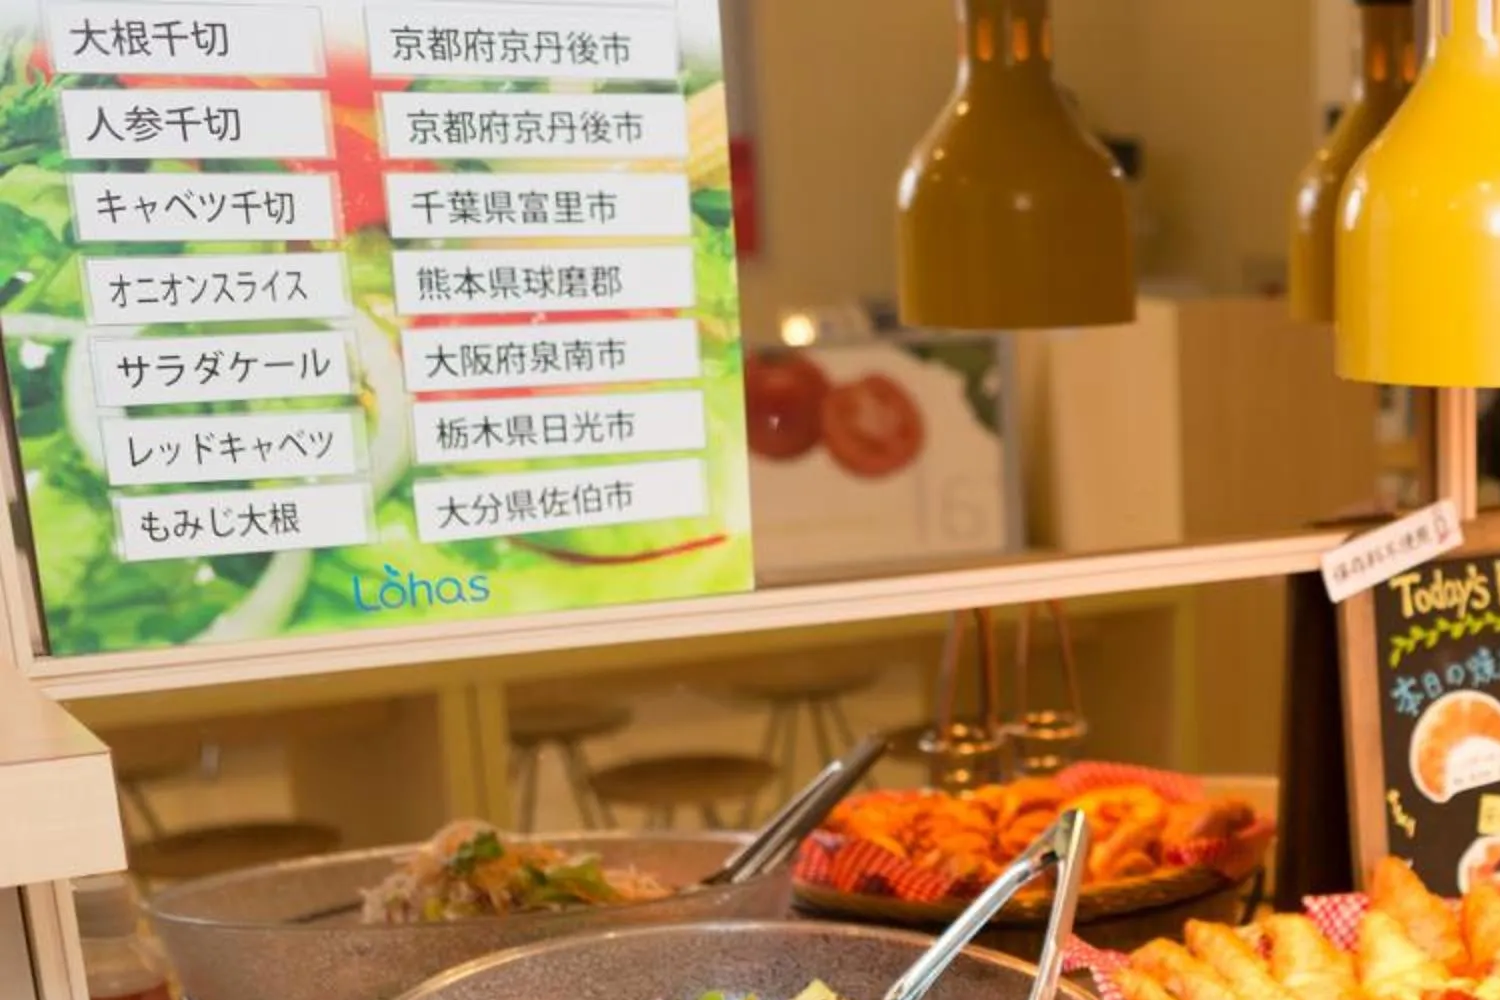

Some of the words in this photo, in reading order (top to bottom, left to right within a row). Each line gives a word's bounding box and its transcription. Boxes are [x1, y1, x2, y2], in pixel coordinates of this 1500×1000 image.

[69, 18, 230, 57] 大根千切
[390, 28, 632, 66] 京都府京丹後市
[86, 105, 241, 144] 人参千切
[407, 110, 644, 146] 京都府京丹後市
[97, 190, 296, 225] キャベツ千切
[411, 190, 618, 226] 千葉県富里市
[109, 270, 308, 309] オニオンスライス
[416, 265, 623, 301] 熊本県球磨郡
[117, 348, 331, 388] サラダケール
[425, 337, 627, 379] 大阪府泉南市
[127, 428, 335, 469] レッドキャベツ
[436, 409, 635, 451] 栃木県日光市
[141, 503, 301, 543] もみじ大根
[437, 480, 634, 530] 大分県佐伯市
[353, 563, 491, 612] Lohas
[1389, 563, 1491, 619] Today's
